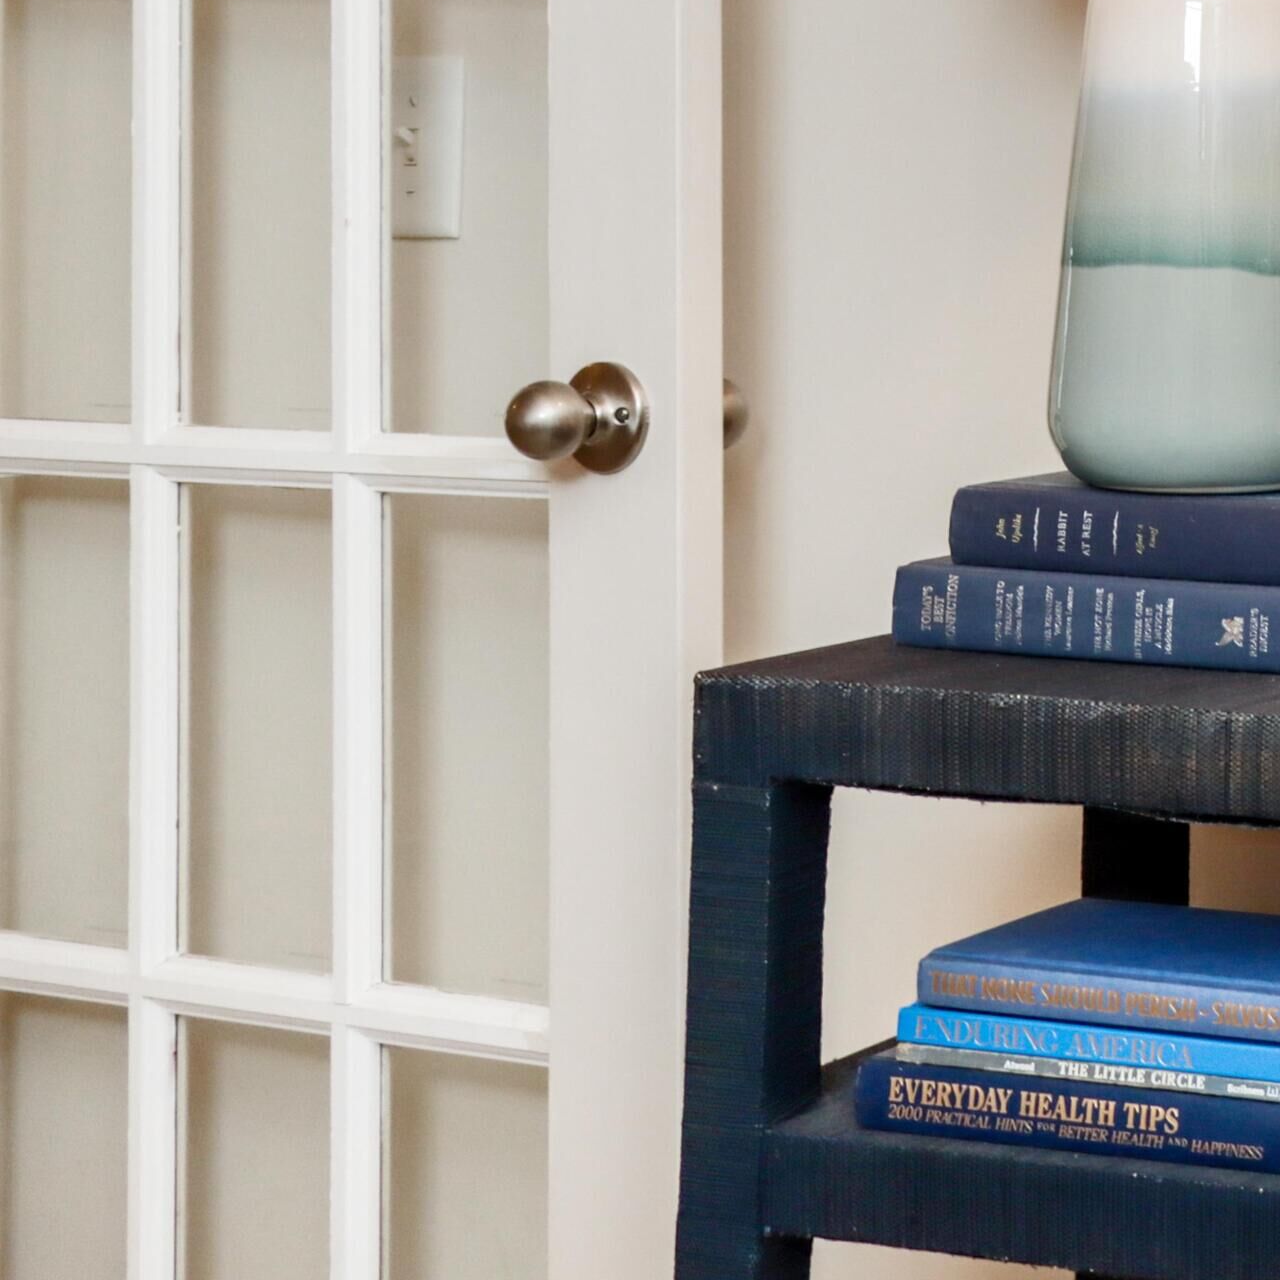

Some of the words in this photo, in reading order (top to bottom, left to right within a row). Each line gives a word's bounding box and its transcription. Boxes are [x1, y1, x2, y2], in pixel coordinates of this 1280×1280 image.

[1057, 510, 1068, 552] RABBIT
[1081, 510, 1093, 538] REST
[1081, 541, 1090, 556] AT
[921, 585, 934, 631] TODAY'S
[933, 595, 945, 624] BEST
[945, 574, 960, 642] ONFICTION
[1249, 608, 1260, 657] READER'S
[1259, 614, 1269, 653] DIGEST
[928, 971, 978, 998] THAT
[981, 975, 1037, 1005] NONE
[1039, 981, 1122, 1014] SHOULD
[1124, 991, 1198, 1023] PERISH
[914, 1015, 1058, 1053] ENDURING
[1065, 1028, 1194, 1069] AMERICA
[1058, 1061, 1089, 1077] THE
[1093, 1063, 1146, 1083] LITTLE
[1151, 1071, 1206, 1091] CIRCLE
[889, 1076, 1014, 1114] EVERYDAY
[1019, 1090, 1116, 1127] HEALTH
[1123, 1103, 1180, 1134] TIPS
[888, 1104, 923, 1122] 2000
[925, 1109, 992, 1130] PRACTICAL
[995, 1117, 1034, 1135] HINTS
[1036, 1122, 1056, 1133] FOR
[1058, 1125, 1108, 1143] BETTER
[1111, 1131, 1164, 1149] HEALTH
[1167, 1137, 1189, 1148] AND
[1191, 1140, 1264, 1160] HAPPINESS
